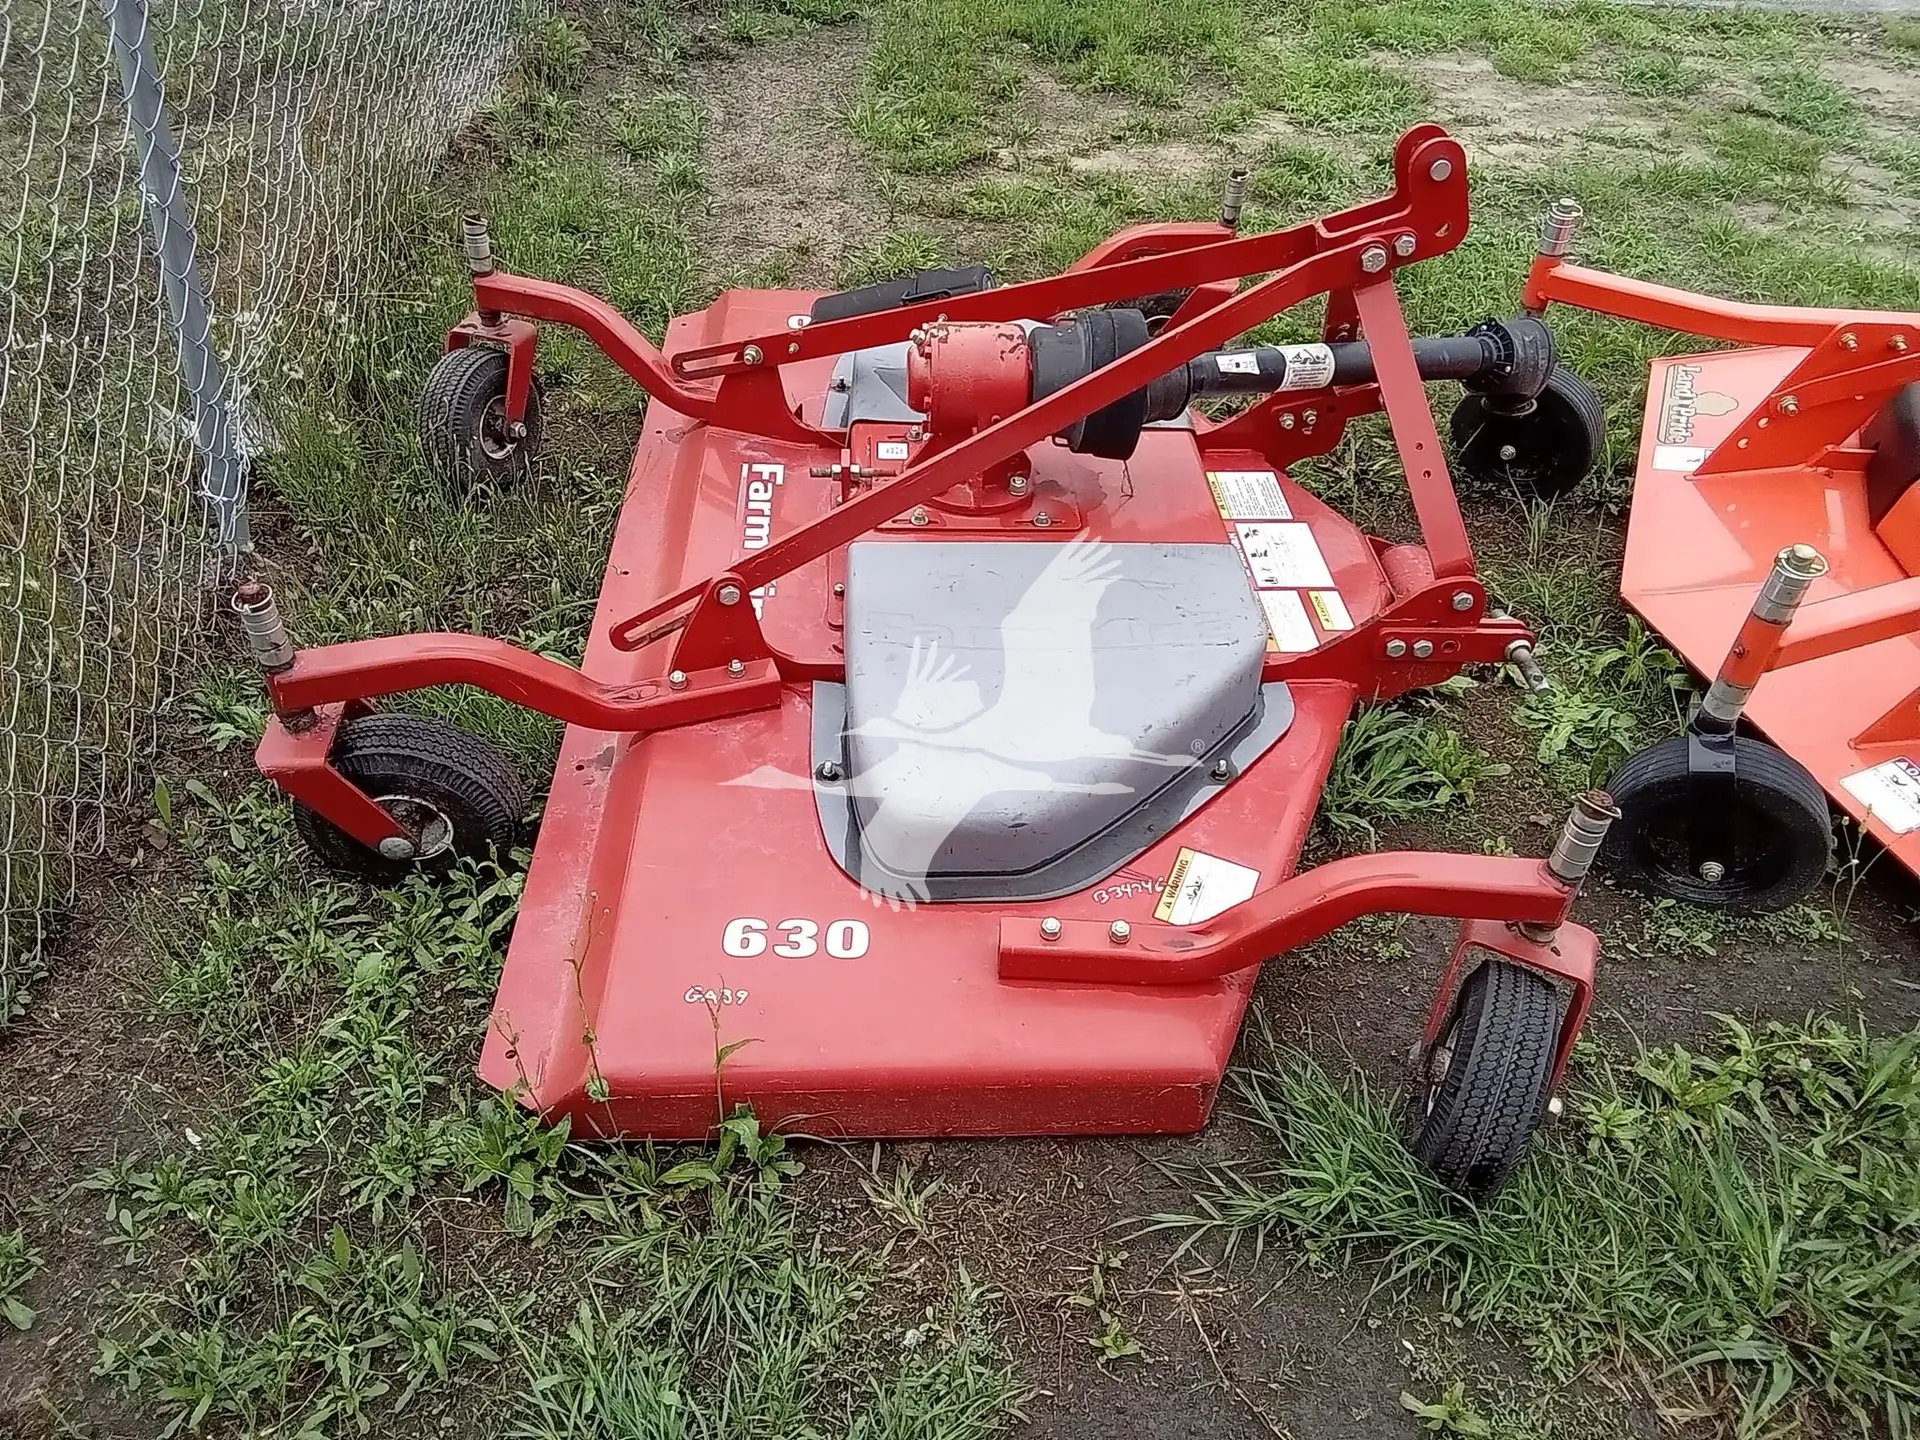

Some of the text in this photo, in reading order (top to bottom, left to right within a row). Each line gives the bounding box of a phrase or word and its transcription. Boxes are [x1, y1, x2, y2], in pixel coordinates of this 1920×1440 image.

[1674, 364, 1702, 400] Land
[1667, 403, 1696, 443] Pride
[743, 463, 785, 549] Farm
[1166, 859, 1189, 898] WARNING
[722, 917, 870, 959] 630
